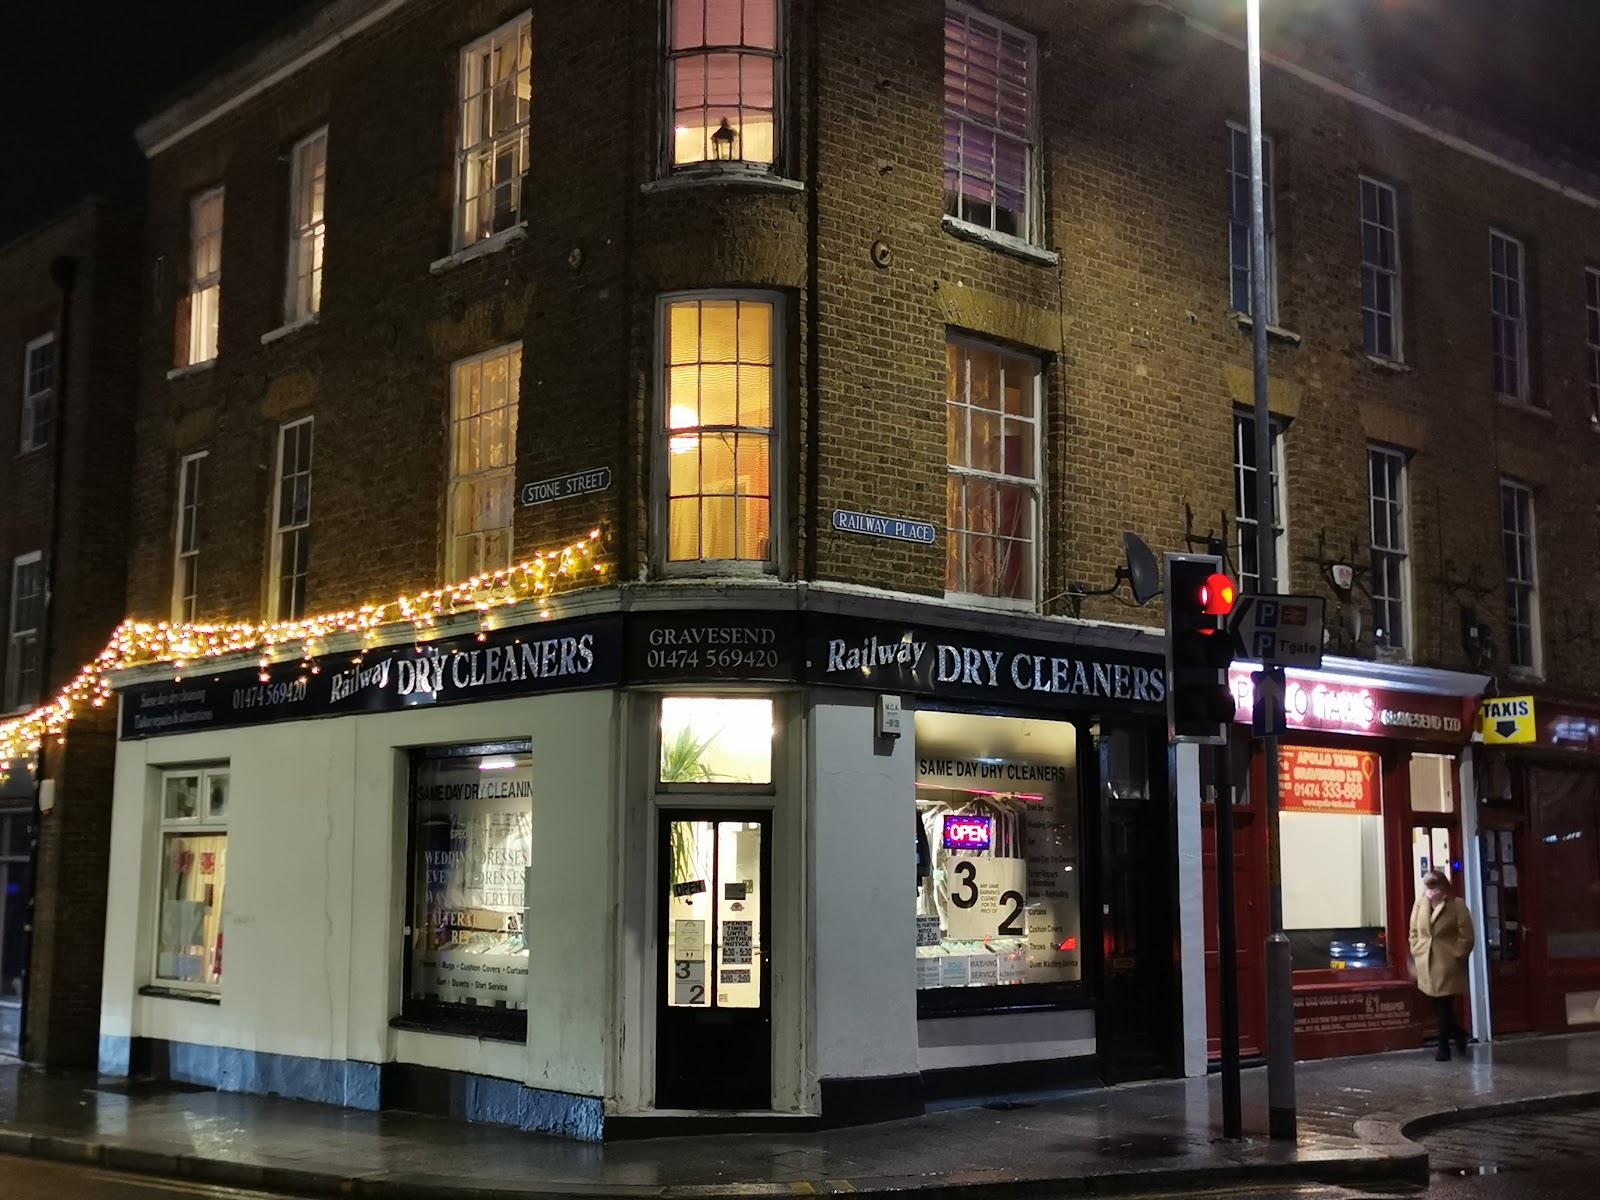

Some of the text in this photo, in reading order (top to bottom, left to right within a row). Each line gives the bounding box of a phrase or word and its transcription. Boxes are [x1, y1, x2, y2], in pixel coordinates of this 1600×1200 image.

[528, 473, 605, 501] STONE STREET
[839, 514, 930, 541] RAILWAY PLACE
[649, 628, 776, 647] GRAVESEND
[330, 633, 594, 704] Railway DRY CLEANERS
[647, 649, 778, 669] 01474 569420
[826, 635, 1165, 702] Railway DRY CLEANERS
[232, 682, 307, 710] 01474 569420
[1484, 701, 1529, 718] TAXIS
[919, 758, 1066, 782] SAME DAY DRY CLEANERS
[445, 784, 464, 800] DAY
[1294, 782, 1320, 797] 01474
[950, 824, 989, 843] OPEN
[677, 881, 702, 896] OPEN
[951, 860, 979, 909] 3
[998, 890, 1025, 936] 2
[460, 963, 481, 971] Cushion
[482, 964, 501, 974] Covers
[506, 966, 529, 976] Curtains
[675, 960, 691, 980] 3
[970, 960, 997, 968] WASHING
[971, 971, 996, 979] SERVICE
[488, 982, 508, 992] Service
[690, 984, 705, 1004] 2
